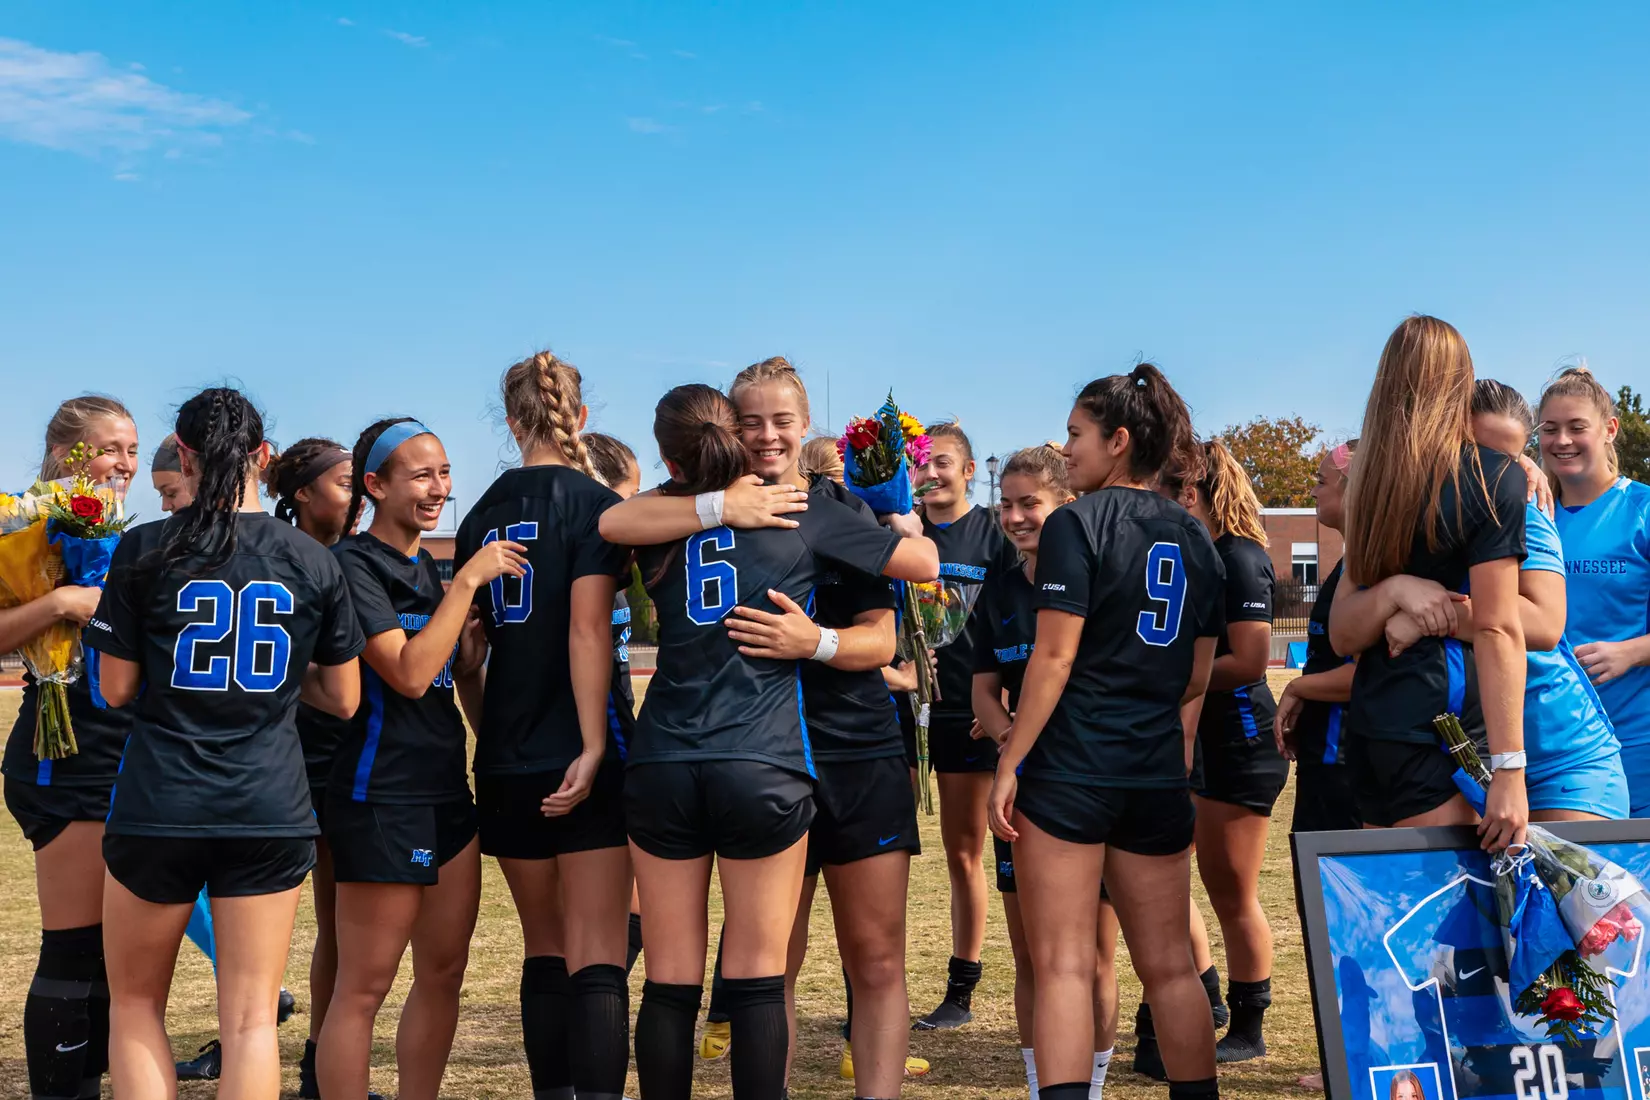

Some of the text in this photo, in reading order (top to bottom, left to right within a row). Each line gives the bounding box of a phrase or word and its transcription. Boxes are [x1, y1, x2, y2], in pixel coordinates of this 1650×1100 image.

[685, 525, 738, 626] 6
[939, 562, 987, 580] NNESSEE
[1136, 542, 1187, 647] 9
[1564, 559, 1627, 574] NNESSEE
[170, 580, 294, 692] 26
[411, 848, 433, 867] MT
[1509, 1044, 1569, 1100] 20
